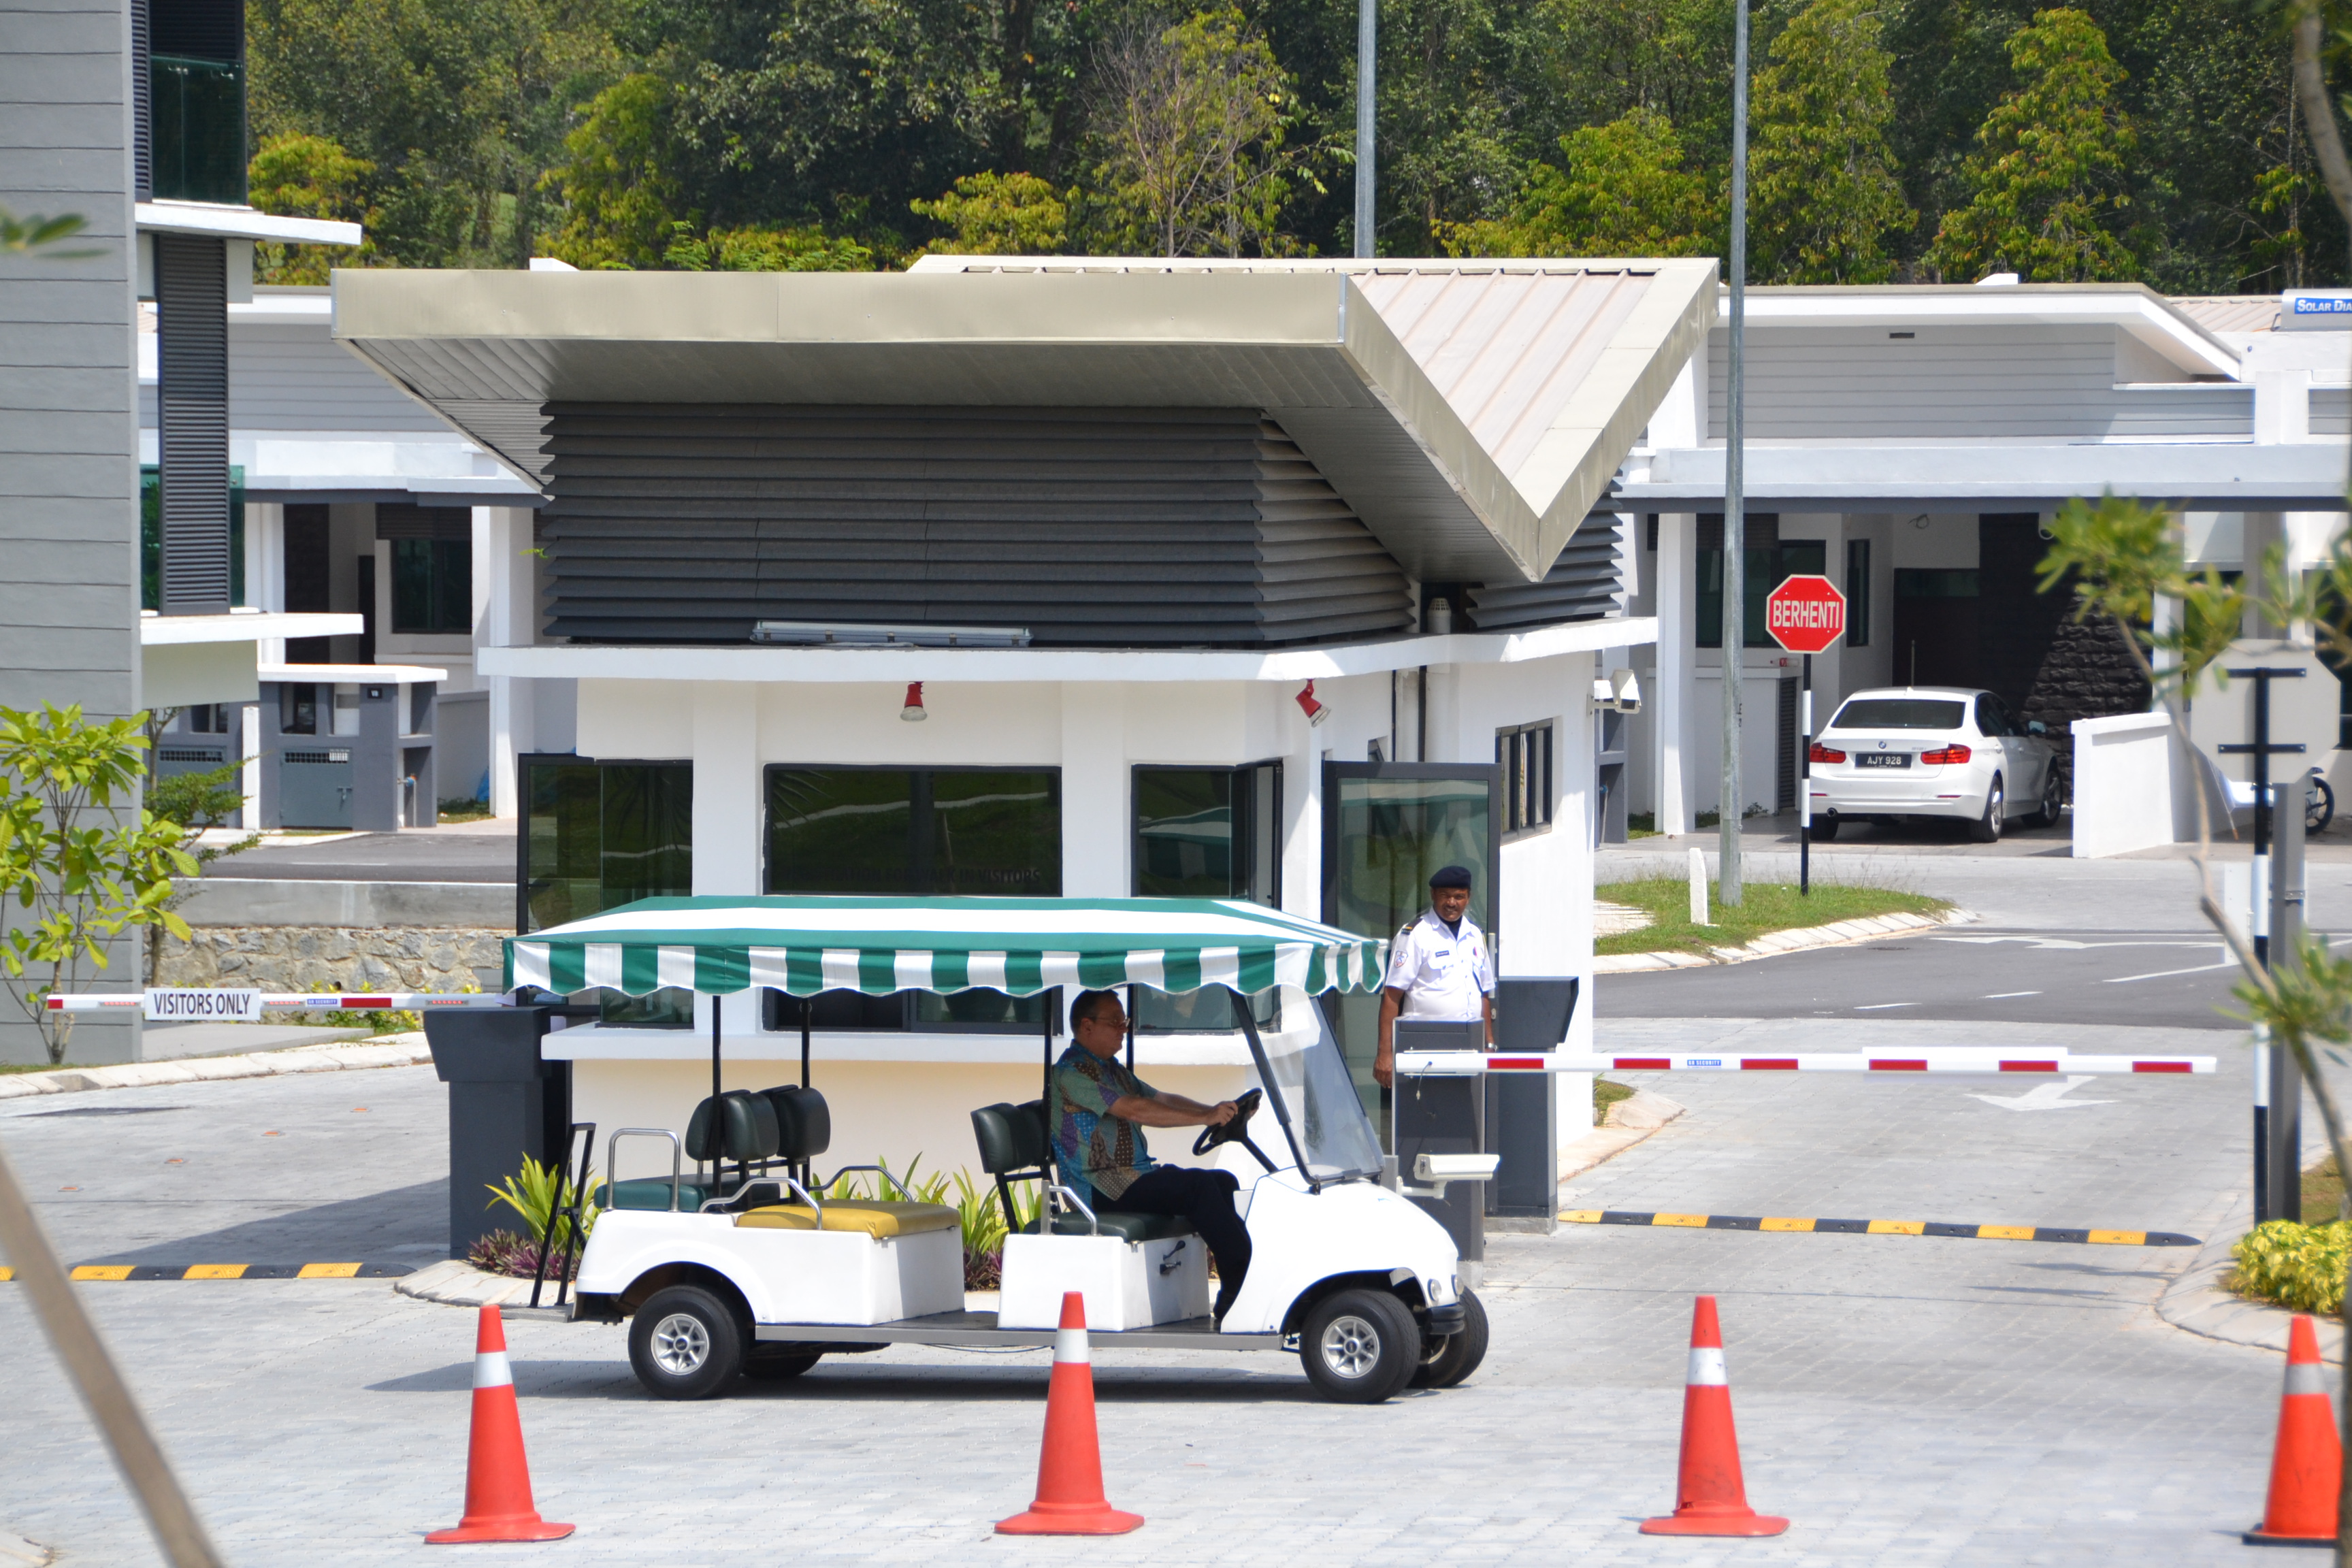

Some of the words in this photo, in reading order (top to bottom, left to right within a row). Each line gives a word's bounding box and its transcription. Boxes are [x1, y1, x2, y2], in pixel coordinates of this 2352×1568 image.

[2298, 299, 2332, 312] SOLAR
[1773, 600, 1840, 629] BERHENTI
[1867, 756, 1883, 765] AJY
[1885, 756, 1901, 765] 928
[959, 868, 975, 883] IN
[978, 868, 1041, 884] VISITORS
[154, 993, 212, 1015] VISITORS
[216, 993, 250, 1015] ONLY
